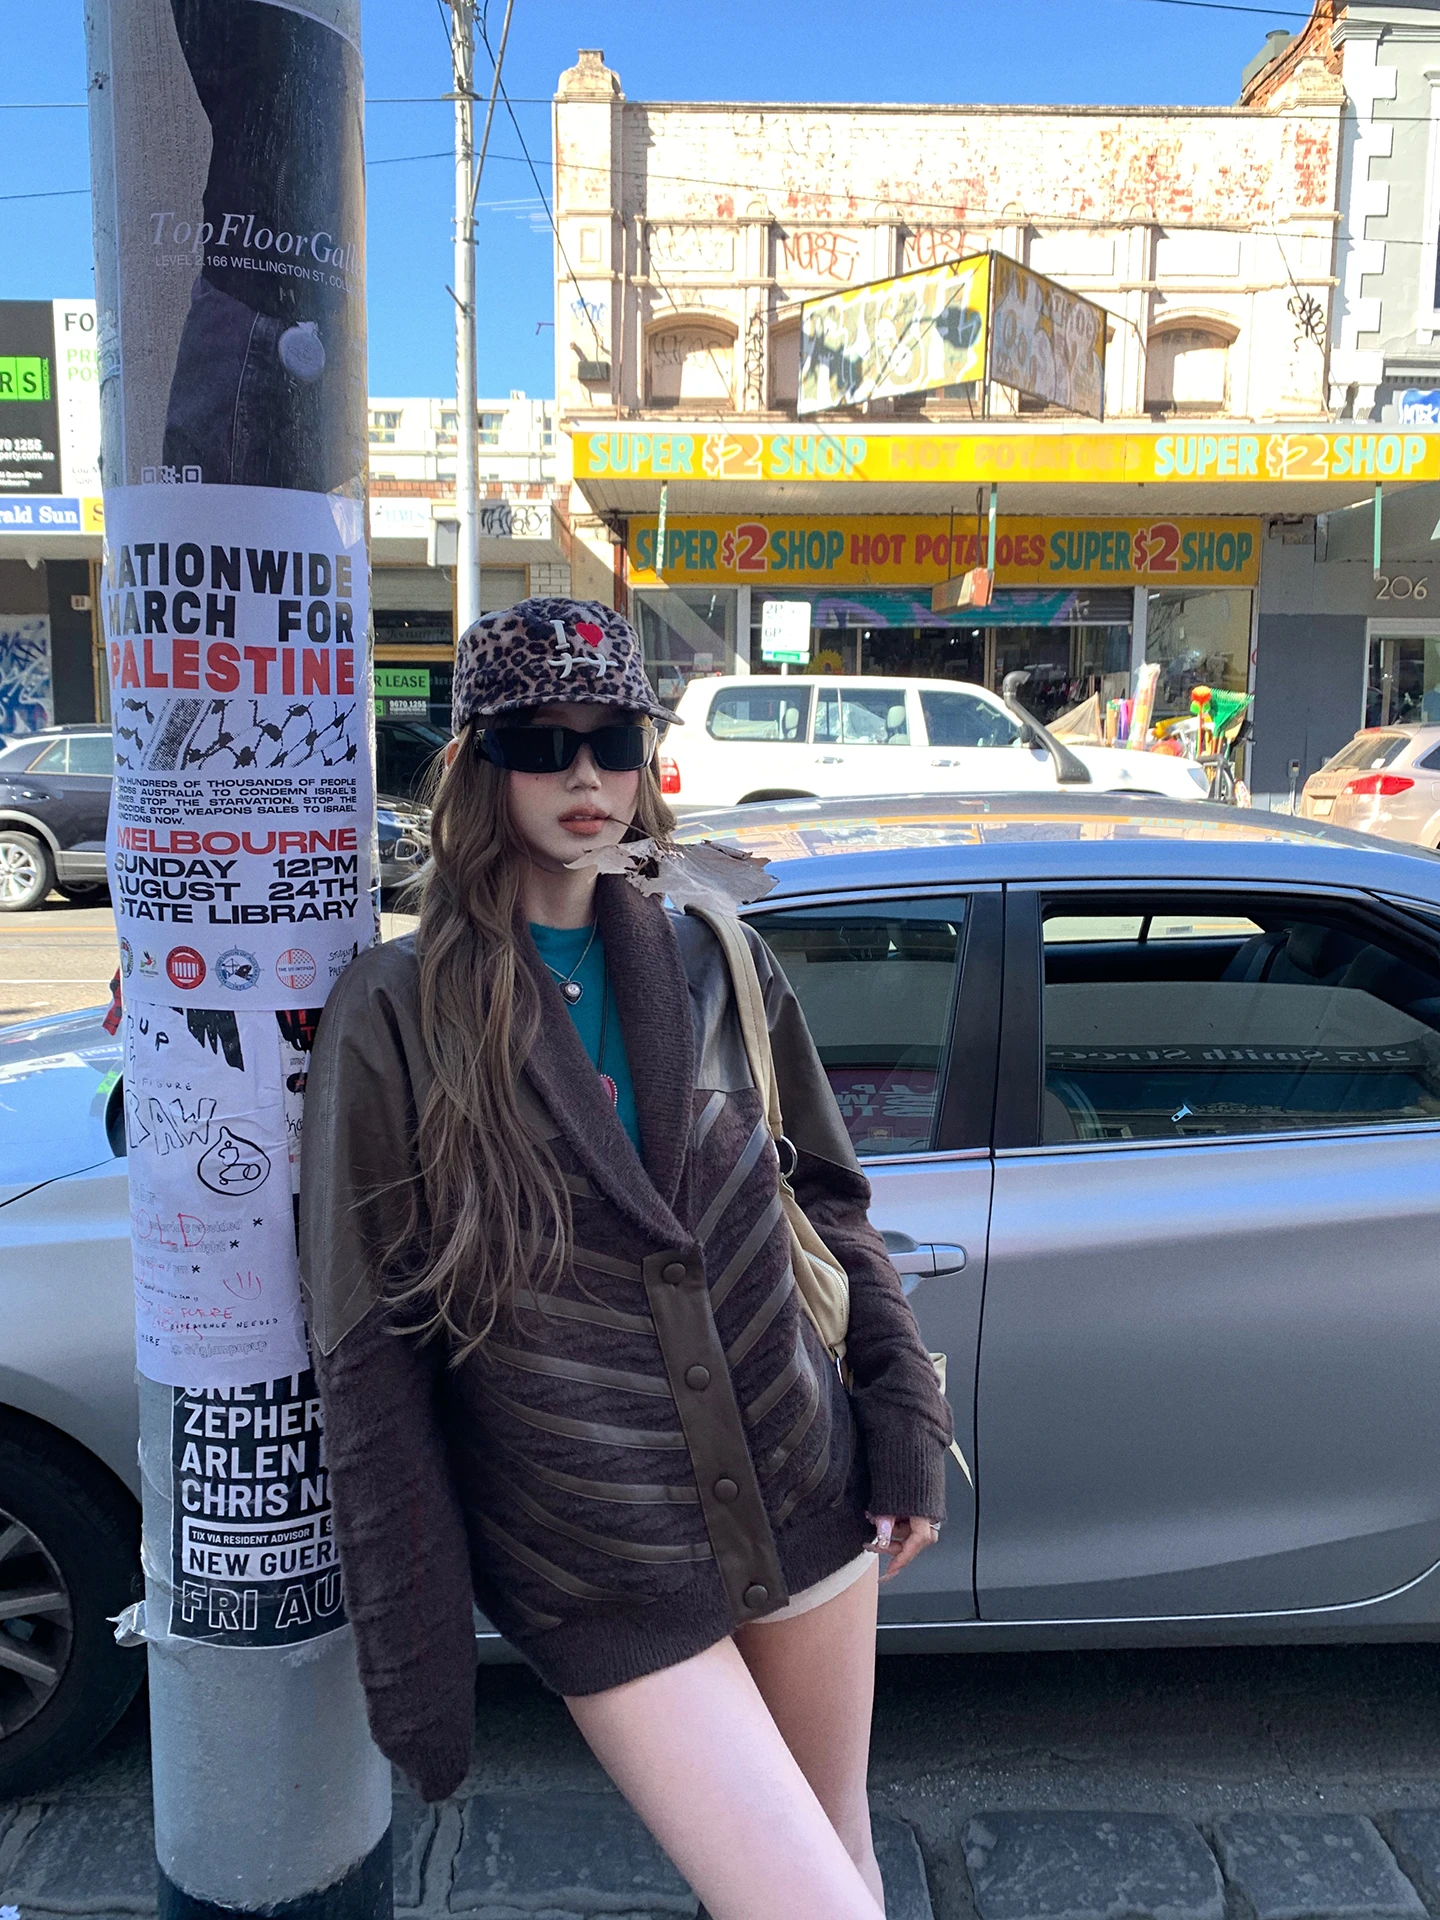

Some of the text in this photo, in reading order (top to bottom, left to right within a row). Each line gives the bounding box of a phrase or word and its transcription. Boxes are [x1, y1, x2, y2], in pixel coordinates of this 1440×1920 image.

[155, 255, 192, 267] LEVEL
[206, 256, 228, 267] 166
[230, 256, 310, 279] WELLINGTON
[588, 433, 1426, 480] SUPER $2 SHOP HOT POTATOES SUPER $2 SHOP
[39, 505, 78, 524] Sun
[636, 522, 1252, 573] SUPER $2 SHOP HOT POTATOES SUPER $2 SHOP
[1375, 576, 1428, 600] 206
[108, 590, 354, 644] MARCH FOR
[110, 638, 354, 696] PALESTINE
[386, 676, 426, 688] LEASE
[126, 777, 178, 788] HUNDREDS
[183, 780, 200, 788] OF
[206, 778, 292, 788] THOUSANDS
[298, 778, 315, 786] OF
[320, 778, 356, 786] PEOPLE
[141, 788, 204, 798] AUSTRALIA
[212, 789, 231, 797] TO
[239, 788, 308, 796] CONDEMN
[140, 797, 166, 806] STOP
[175, 798, 200, 806] THE
[209, 797, 294, 806] STARVATION.
[303, 796, 334, 804] STOP
[340, 796, 356, 804] THE
[150, 806, 180, 815] STOP
[184, 807, 252, 816] WEAPONS
[257, 806, 300, 814] SALES
[304, 805, 320, 813] TO
[154, 816, 185, 826] NOW.
[116, 826, 358, 855] MELBOURNE
[114, 852, 358, 879] SUNDAY 12PM
[117, 875, 358, 902] AUGUST 24TH
[118, 898, 359, 924] STATE LIBRARY
[142, 1078, 192, 1090] FIGURE
[236, 1318, 278, 1328] NEEDED
[180, 1441, 306, 1480] ARLEN
[182, 1478, 288, 1518] CHRIS
[192, 1528, 310, 1545] TIX VIA RESIDENT ADVISOR
[189, 1547, 250, 1577] NEW
[182, 1580, 258, 1630] FRI
